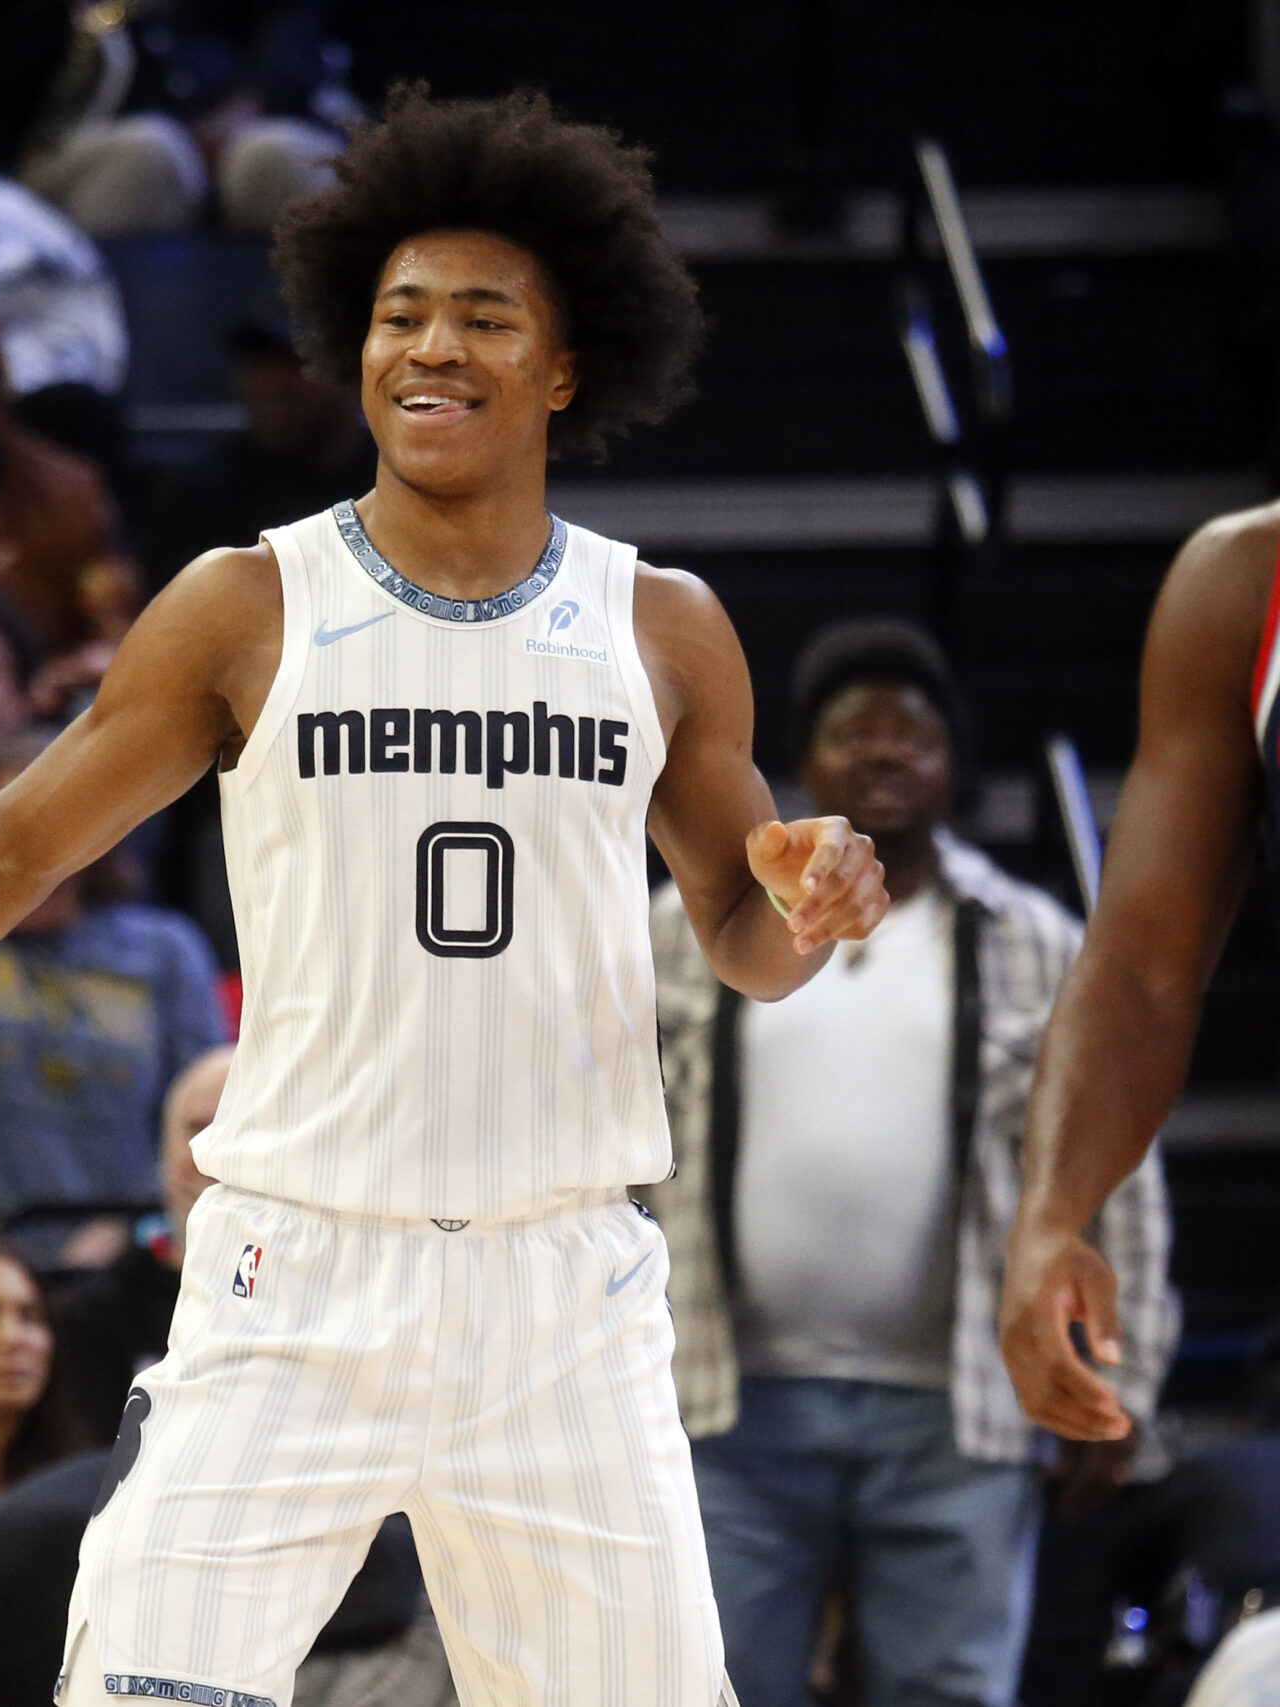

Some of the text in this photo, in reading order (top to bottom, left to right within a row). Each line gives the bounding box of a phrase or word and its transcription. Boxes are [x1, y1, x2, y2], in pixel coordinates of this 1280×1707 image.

[526, 639, 607, 661] Robinhood
[297, 701, 629, 789] memphis
[416, 821, 515, 959] 0
